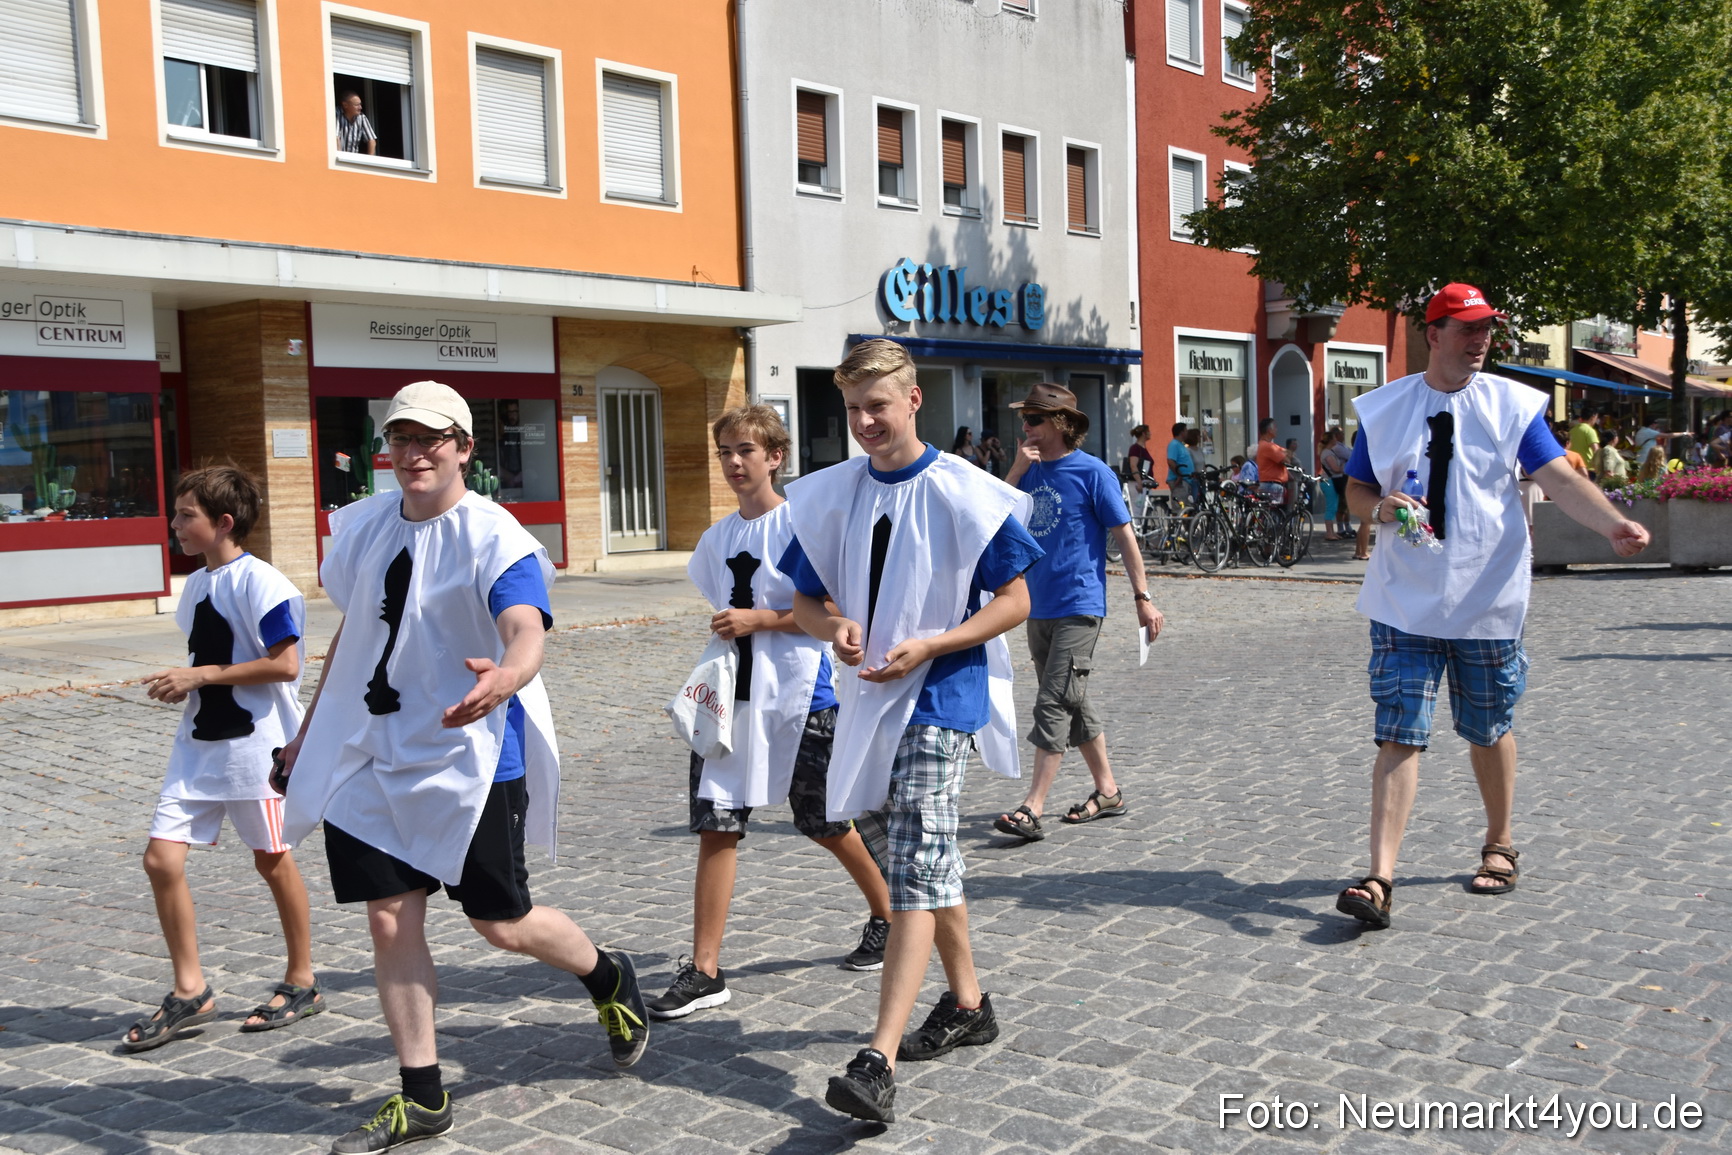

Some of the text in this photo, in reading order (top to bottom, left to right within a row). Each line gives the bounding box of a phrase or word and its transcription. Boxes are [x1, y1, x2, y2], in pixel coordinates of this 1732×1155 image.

[880, 257, 1014, 327] Eilles
[39, 300, 87, 320] Optik
[39, 326, 123, 344] CENTRUM
[369, 320, 471, 340] Reissinger Optik
[439, 345, 497, 358] CENTRUM
[1189, 349, 1233, 372] fielmann
[769, 365, 779, 377] 31
[572, 384, 584, 397] 30
